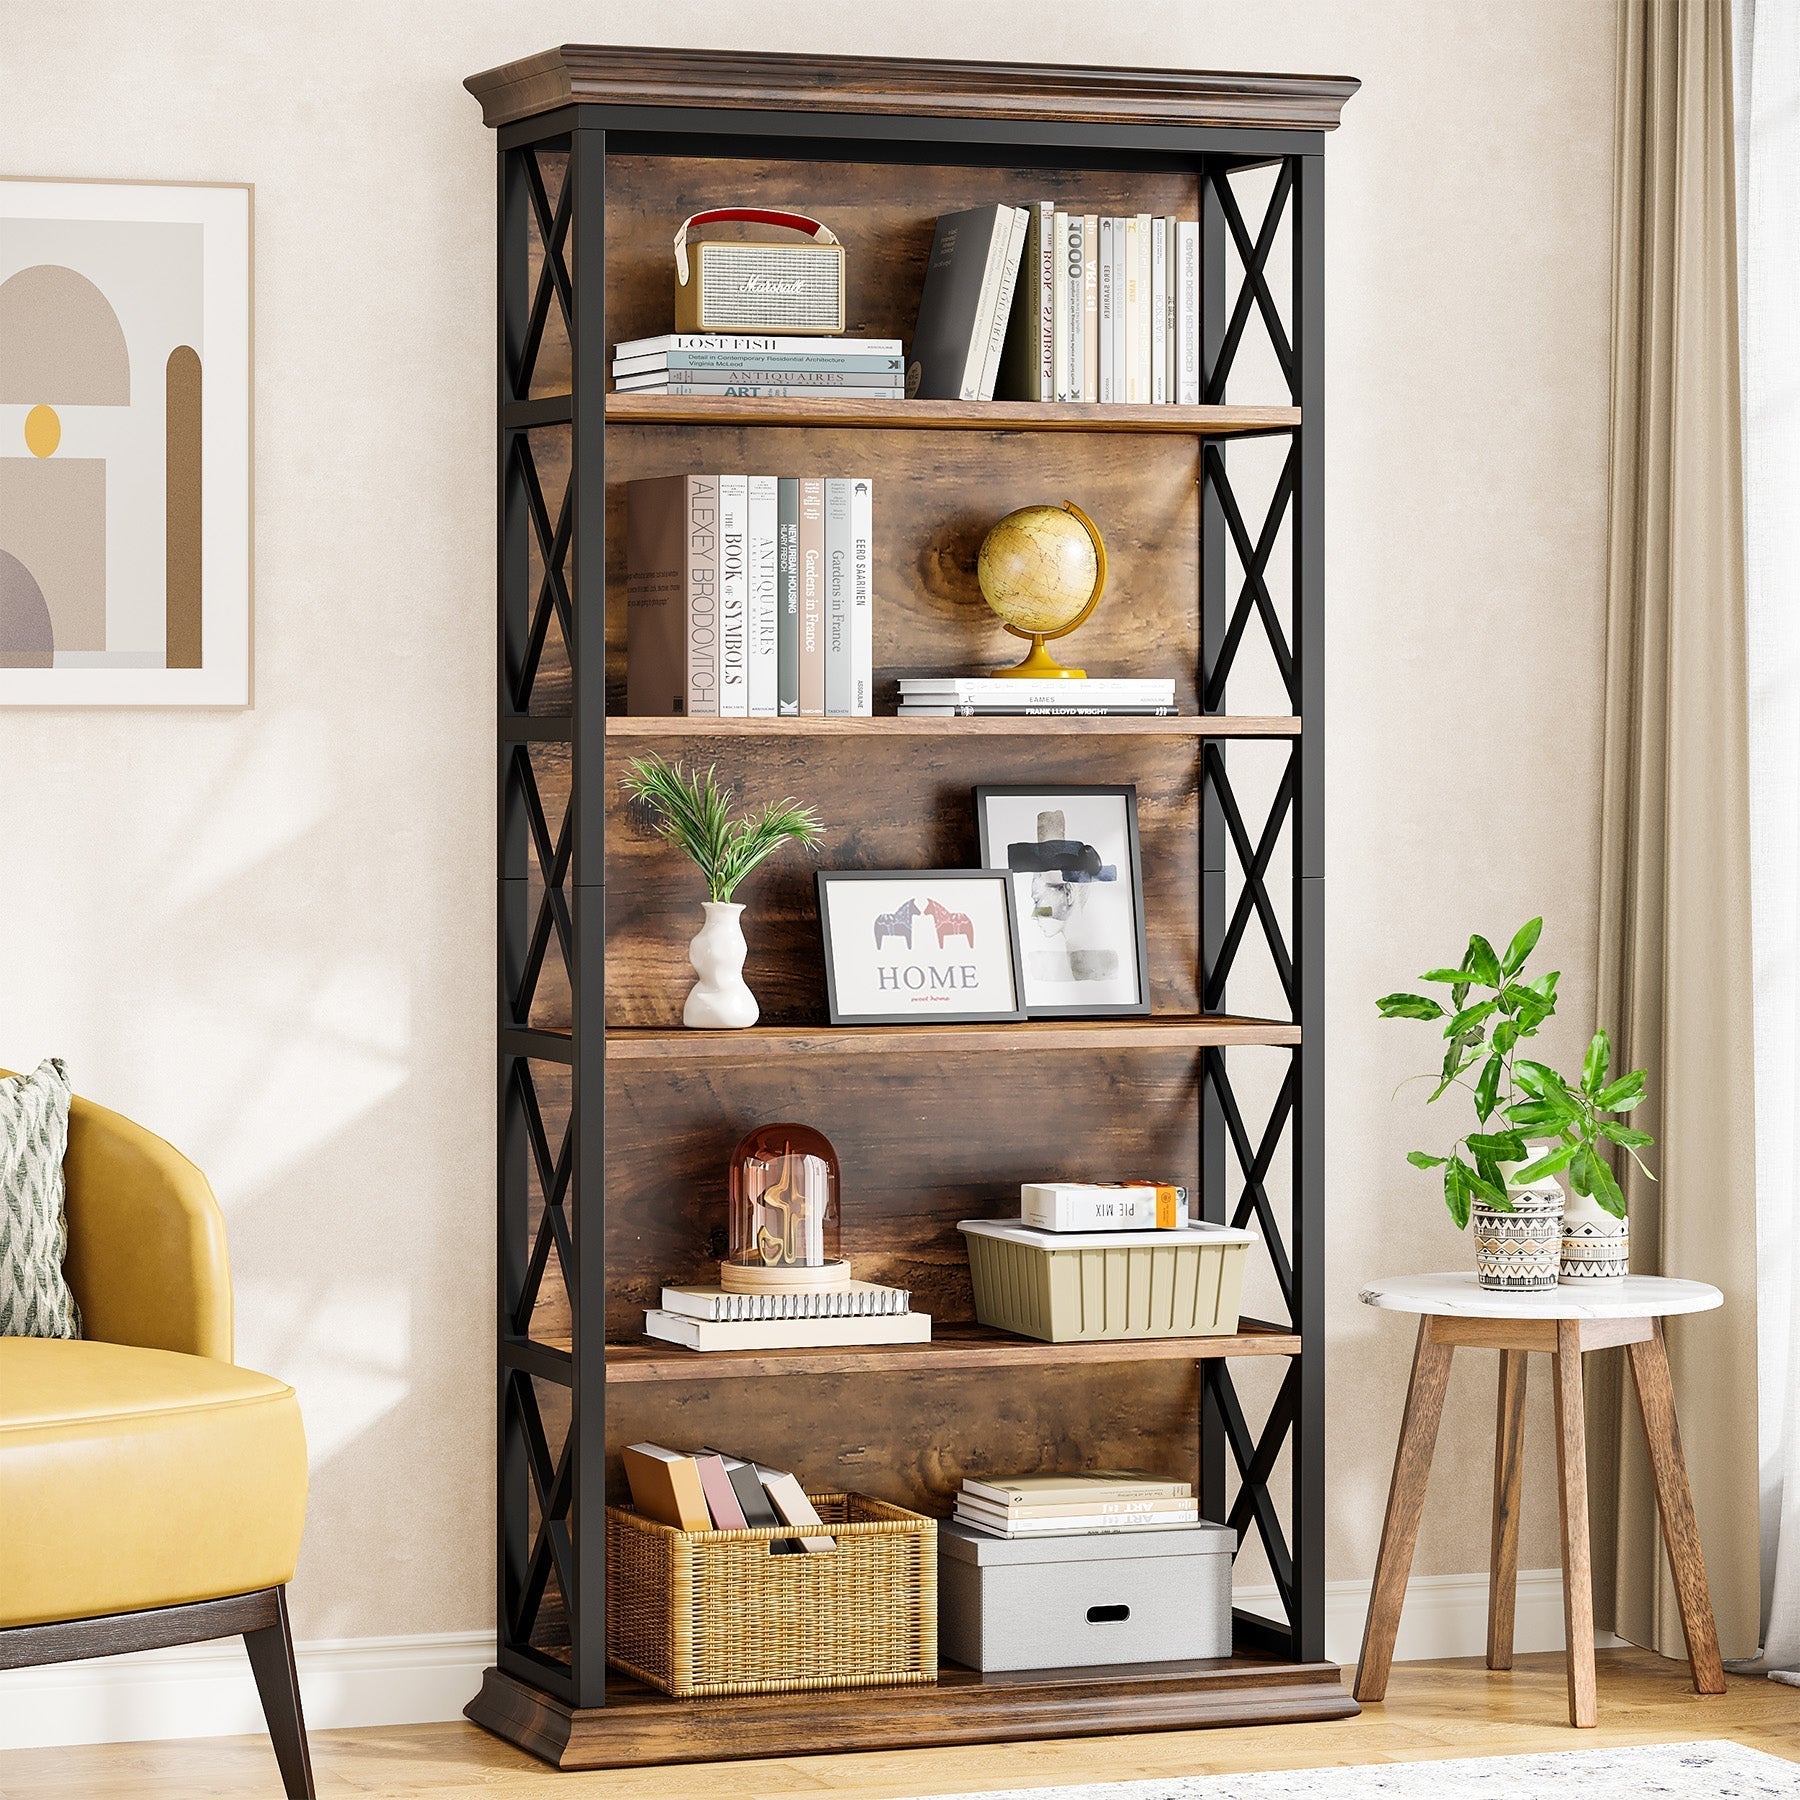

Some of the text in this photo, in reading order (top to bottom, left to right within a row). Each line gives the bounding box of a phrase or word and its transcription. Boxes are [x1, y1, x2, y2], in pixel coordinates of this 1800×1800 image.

[739, 272, 807, 294] Marshall
[677, 337, 777, 351] LOST FISH
[688, 353, 709, 362] Detail
[718, 354, 765, 364] Contemporary
[766, 355, 803, 363] Residential
[804, 356, 846, 364] Architecture
[729, 372, 844, 383] ANTIQUAIRES
[724, 387, 760, 397] ART
[724, 512, 733, 529] THE
[724, 533, 743, 581] BOOK
[780, 523, 788, 573] HILARY FRENCH
[788, 523, 798, 614] NEW URBAN HOUSING
[855, 538, 866, 606] EERO SAARINEN
[691, 480, 715, 704] ALEXEY BRODOVITCH
[724, 585, 733, 596] OF
[758, 537, 775, 656] ANTIQUAIRES
[805, 549, 820, 653] Gardens in France
[832, 549, 846, 653] Gardens in France
[724, 600, 743, 685] SYMBOLS
[1025, 707, 1109, 716] FRANK LLOYD WRIGHT
[877, 965, 980, 991] HOME
[1095, 1203, 1135, 1217] PIE MIX
[1123, 1502, 1154, 1513] ART
[1123, 1514, 1154, 1525] ART
